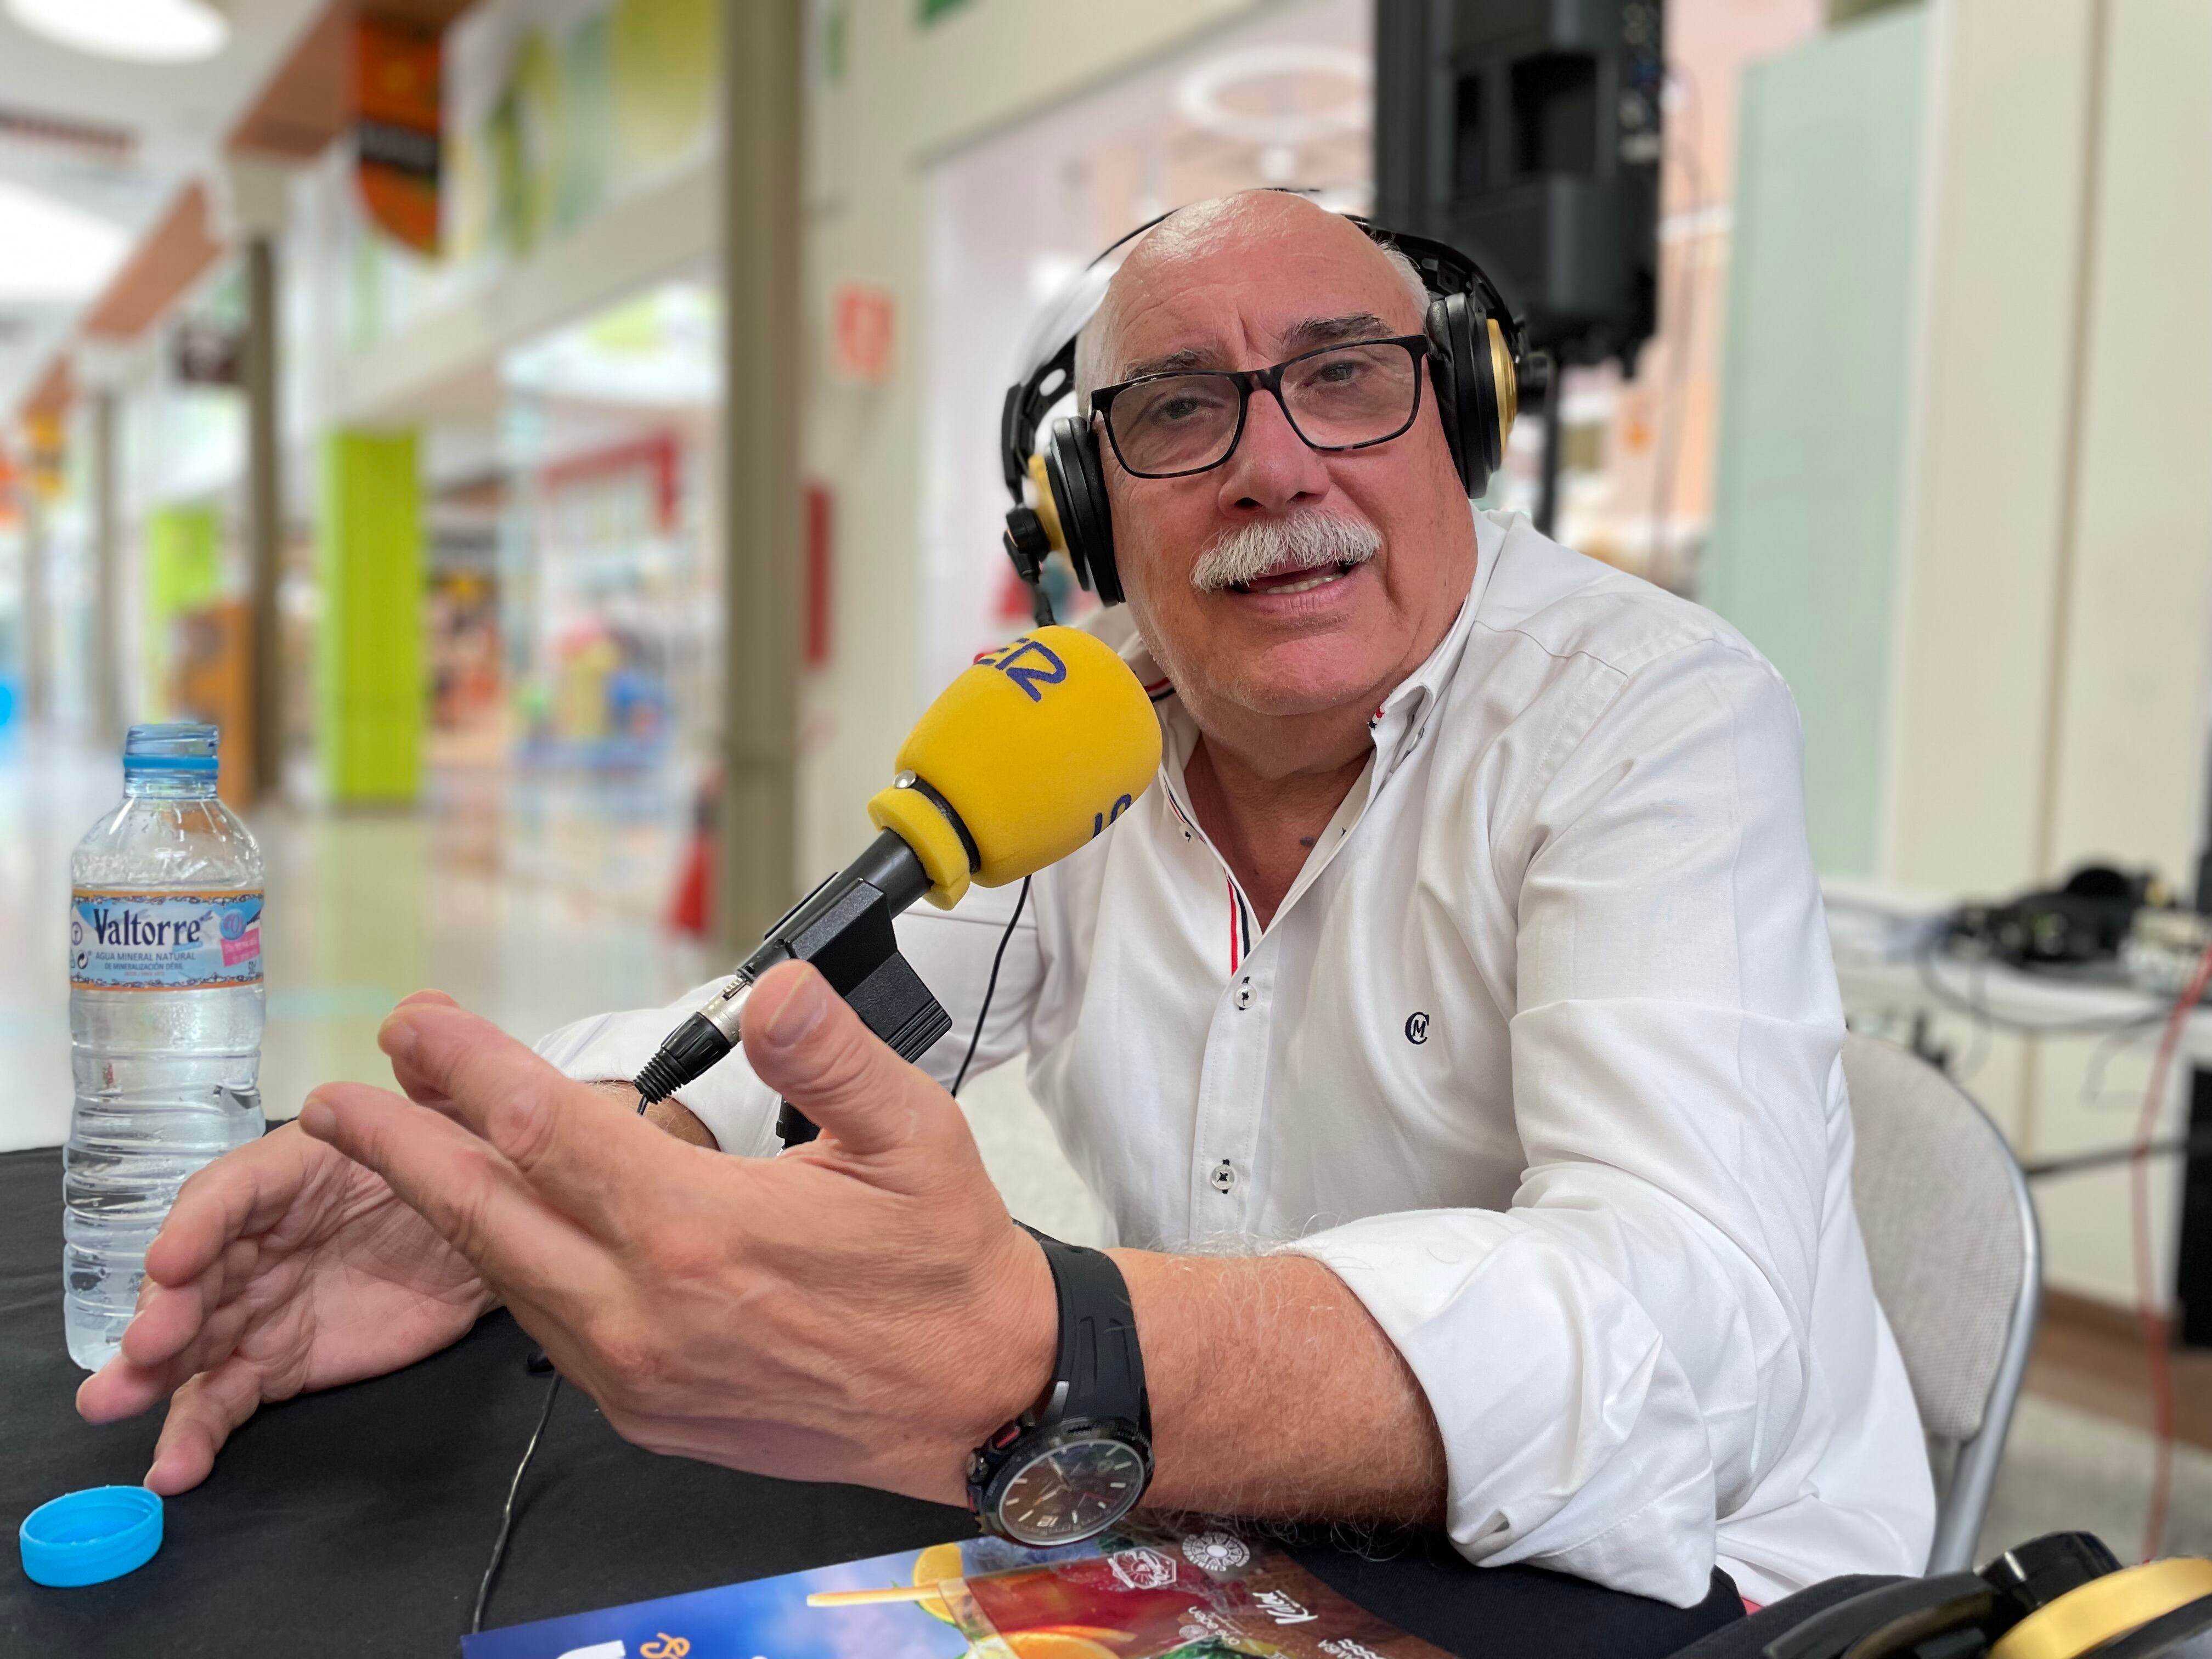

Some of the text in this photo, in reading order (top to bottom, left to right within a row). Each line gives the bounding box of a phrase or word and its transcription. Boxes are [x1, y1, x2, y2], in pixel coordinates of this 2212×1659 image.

[93, 909, 201, 945] Valtorre
[95, 951, 196, 961] AGUA MINERAL NATURAL
[112, 961, 164, 970] MINERALIZACIÓN
